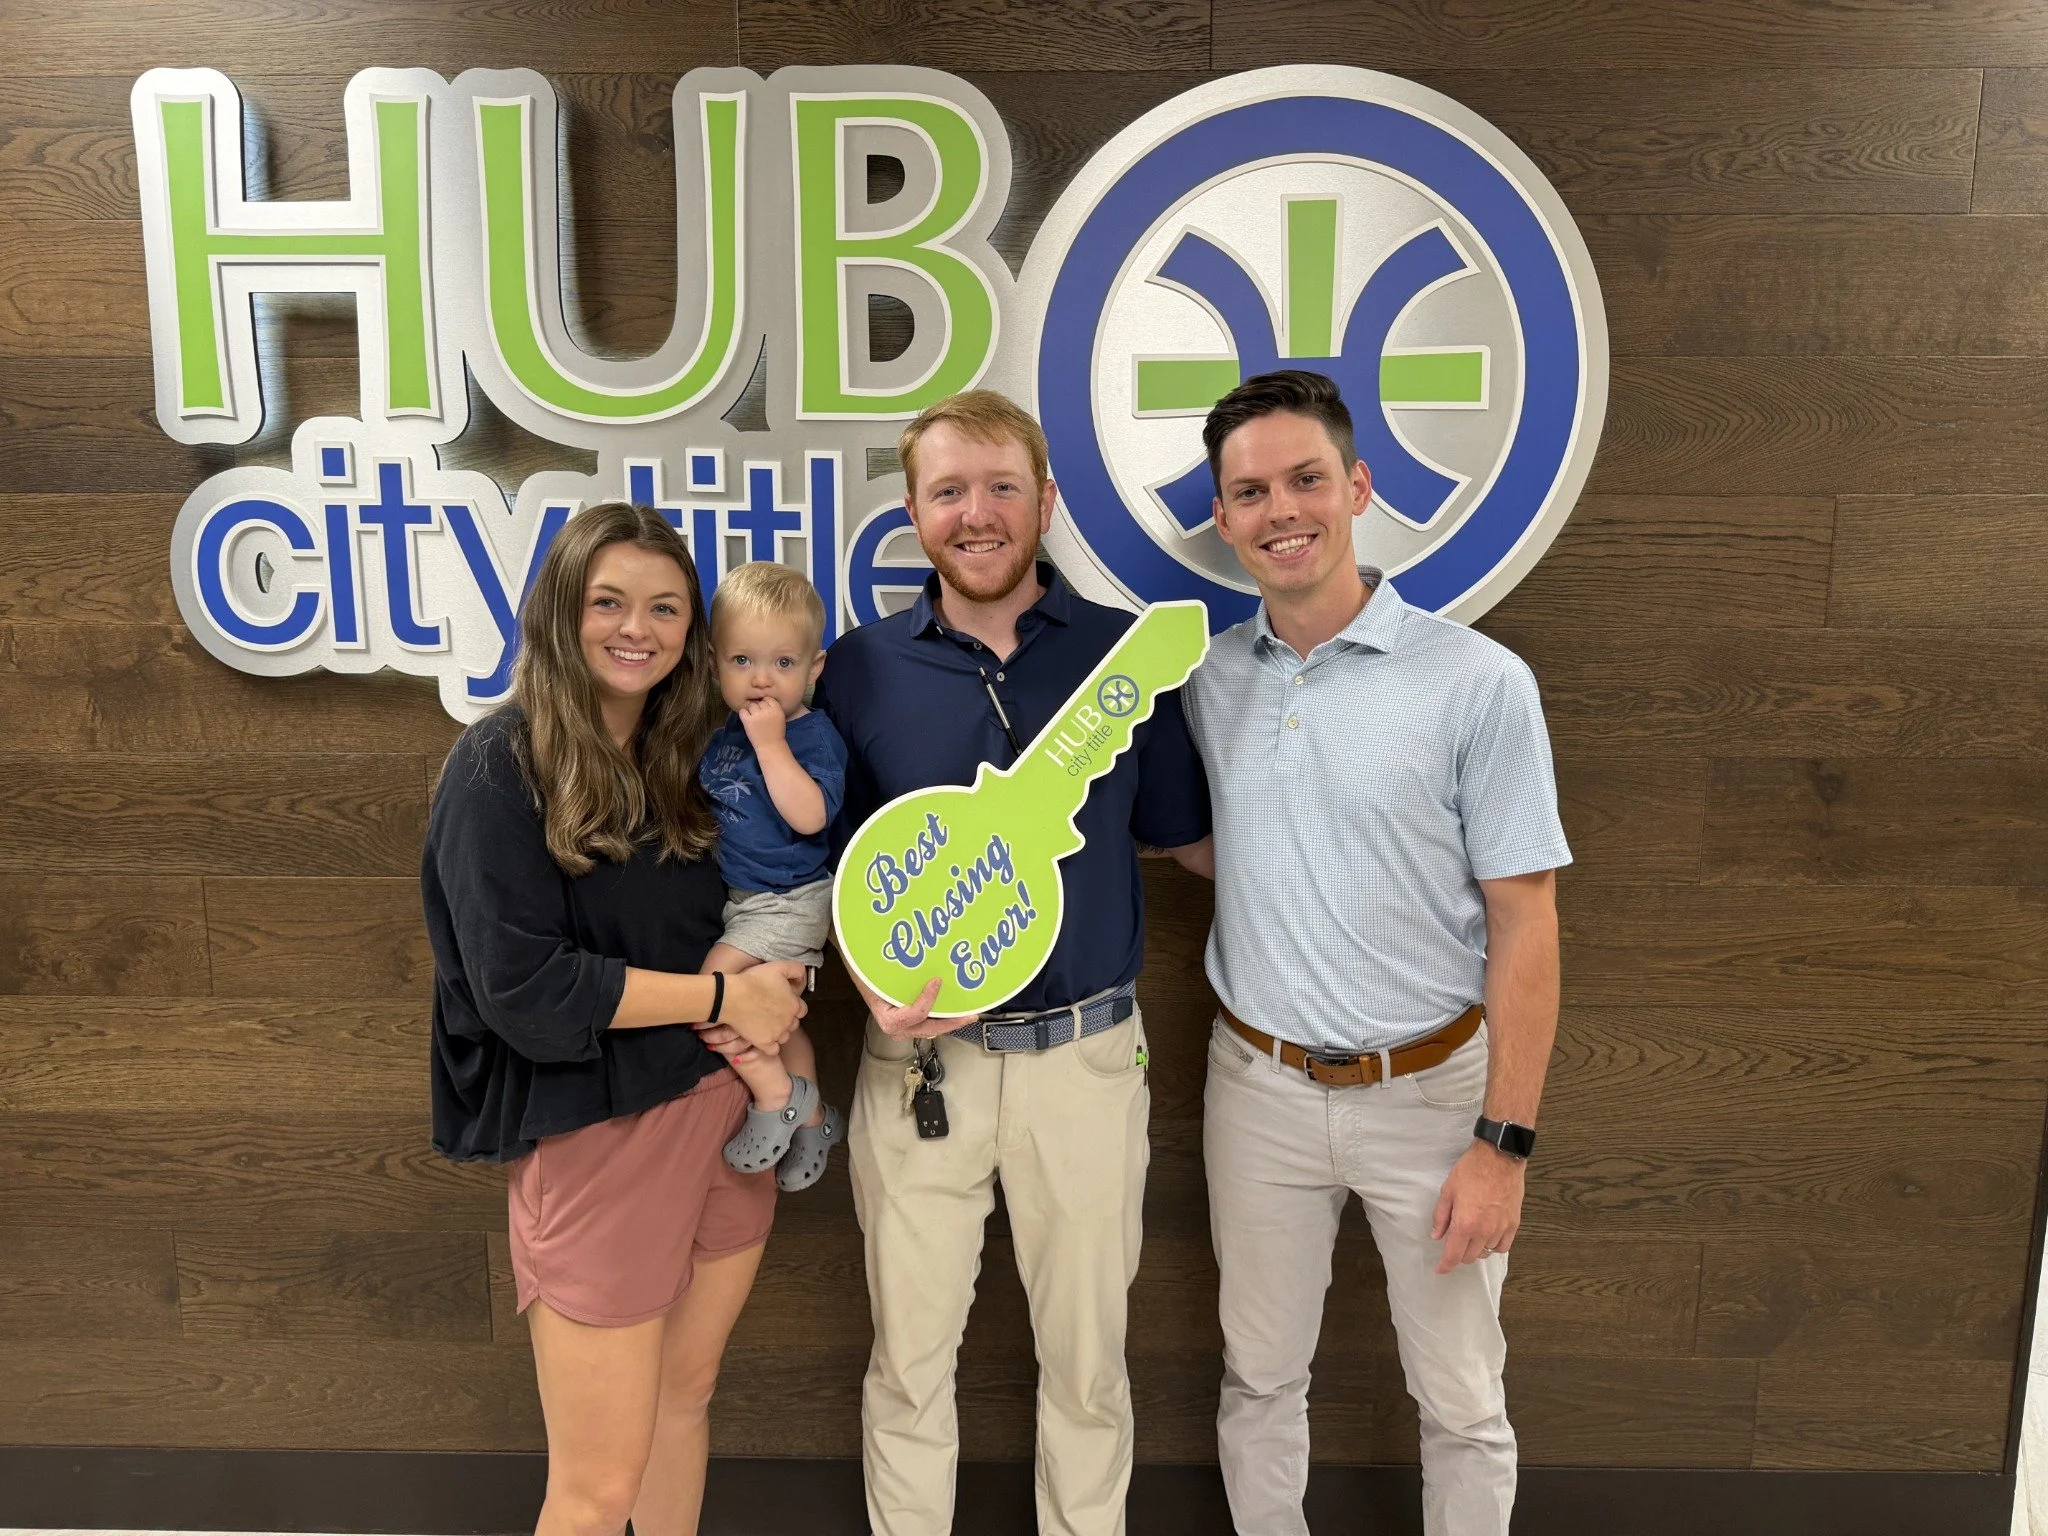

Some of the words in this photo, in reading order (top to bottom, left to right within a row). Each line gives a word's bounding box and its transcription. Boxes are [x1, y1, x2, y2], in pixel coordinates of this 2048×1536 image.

[159, 93, 998, 423] HUB
[196, 446, 572, 700] city
[1044, 704, 1103, 767] HUB
[1066, 748, 1093, 777] city
[1085, 723, 1113, 753] title
[866, 813, 949, 914] Best
[883, 834, 1015, 969] Closing
[949, 880, 1036, 990] Ever!
